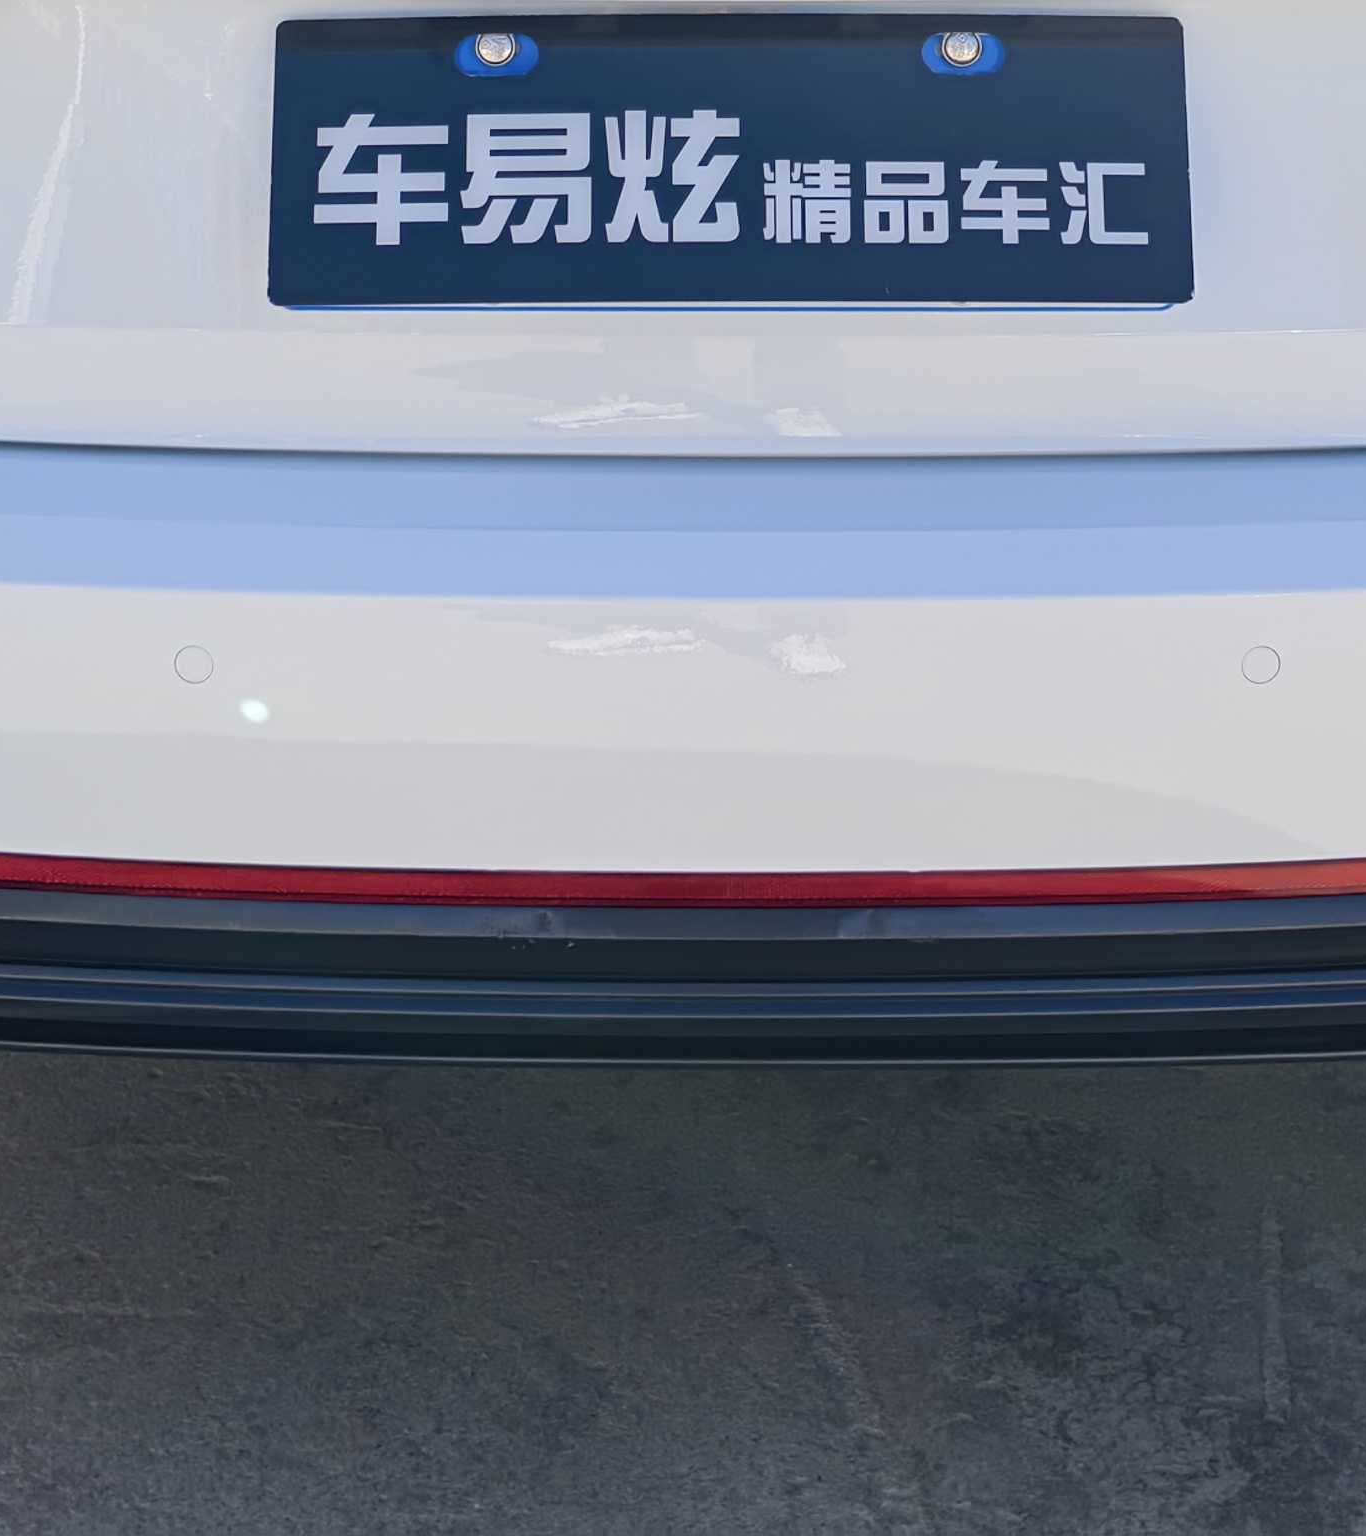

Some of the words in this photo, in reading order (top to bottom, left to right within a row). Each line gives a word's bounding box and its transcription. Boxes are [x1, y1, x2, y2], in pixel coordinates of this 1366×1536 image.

[313, 109, 741, 246] 车易炫
[763, 159, 1149, 245] 精品车汇
